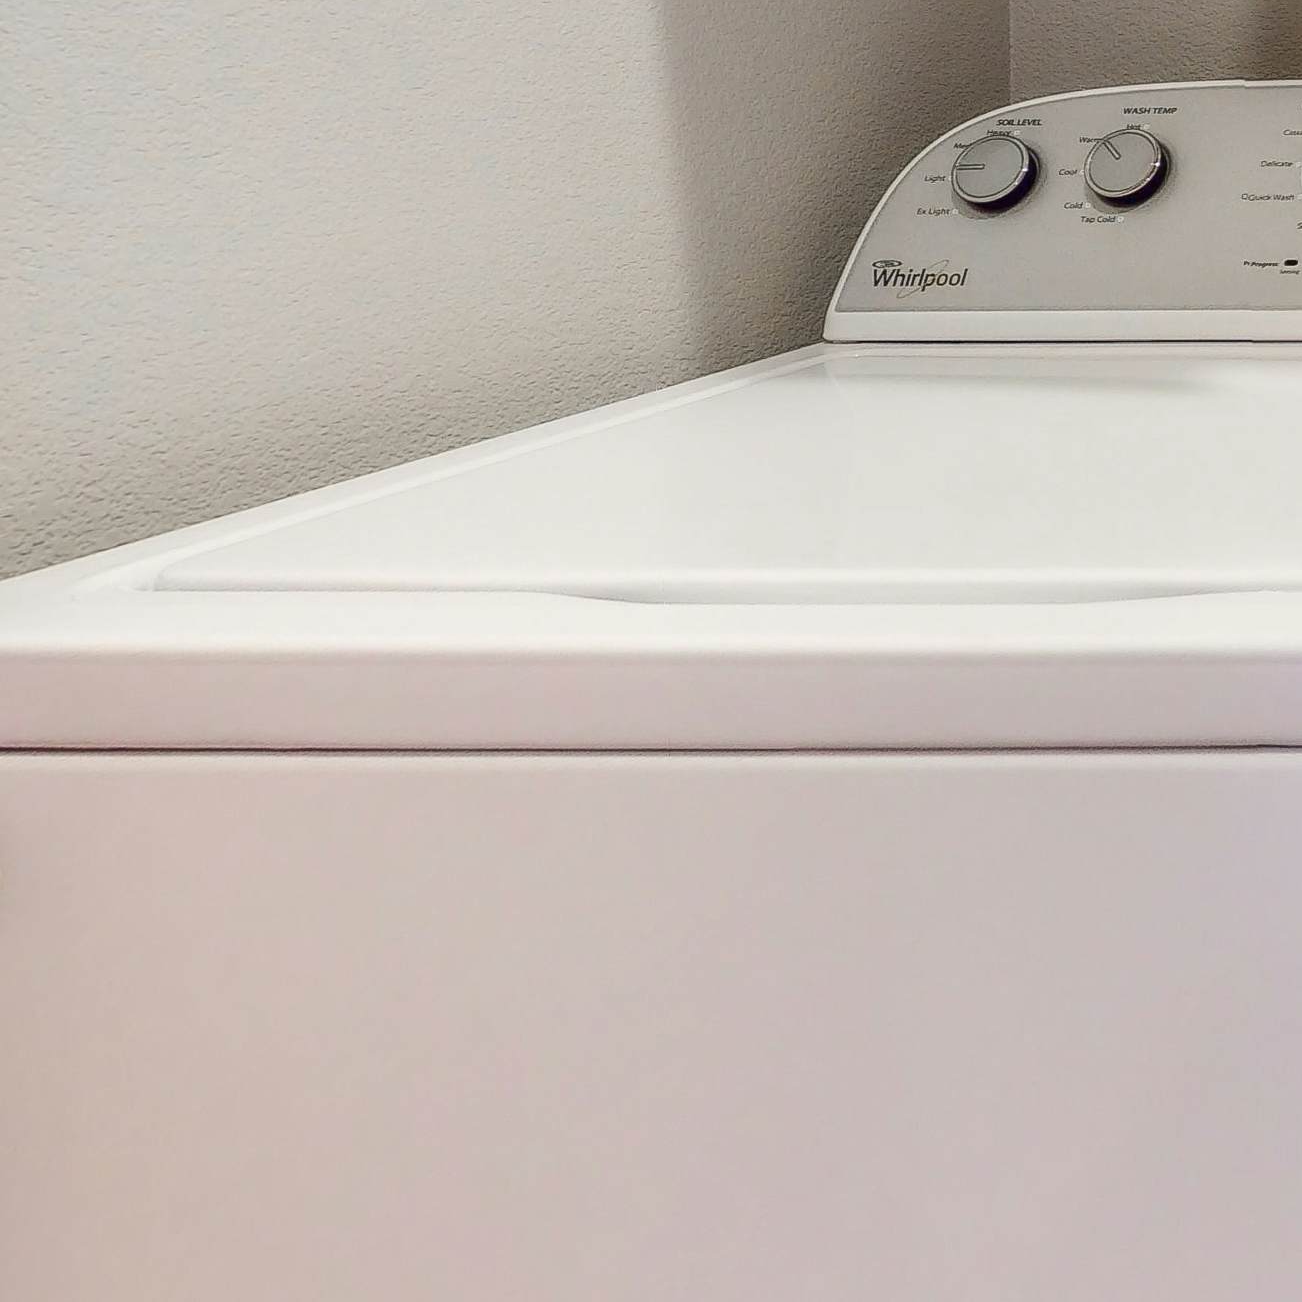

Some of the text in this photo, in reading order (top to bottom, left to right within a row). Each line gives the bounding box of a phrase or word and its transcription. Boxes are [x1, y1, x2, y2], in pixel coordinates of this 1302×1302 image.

[1153, 106, 1178, 114] TEMP
[1260, 160, 1294, 168] Delicate
[924, 174, 946, 182] Light
[1064, 202, 1084, 210] Cold
[928, 208, 950, 216] Light
[1080, 216, 1094, 224] Tap
[873, 268, 968, 292] Whirlpool
